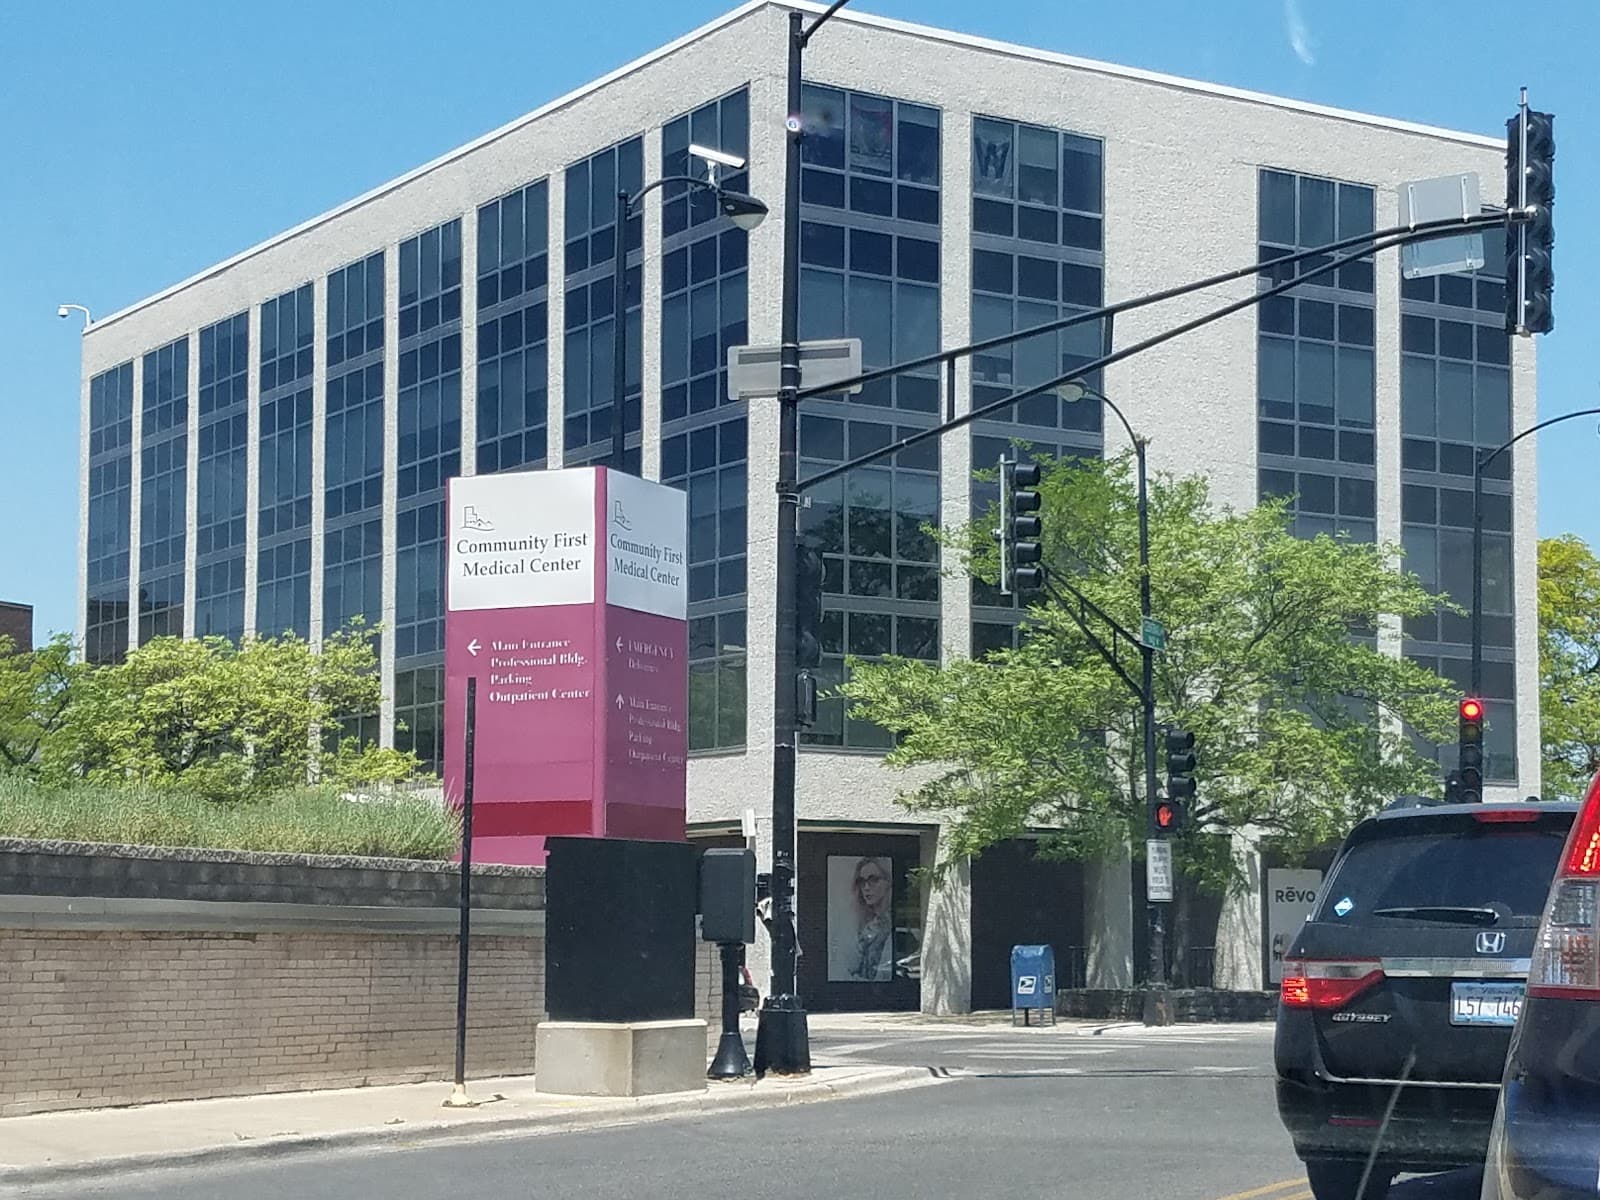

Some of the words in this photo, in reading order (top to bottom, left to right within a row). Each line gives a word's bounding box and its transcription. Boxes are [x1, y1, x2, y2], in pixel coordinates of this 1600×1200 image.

[456, 535, 548, 554] Community
[554, 532, 588, 548] First
[610, 533, 662, 564] Community
[664, 546, 683, 565] First
[463, 559, 524, 577] Medical
[530, 557, 582, 573] Center
[614, 556, 648, 580] Medical
[650, 566, 680, 587] Center
[491, 653, 557, 668] Professional
[490, 672, 533, 686] Parking
[489, 689, 549, 705] Outpatient
[551, 687, 591, 699] Center
[1457, 995, 1484, 1016] L57
